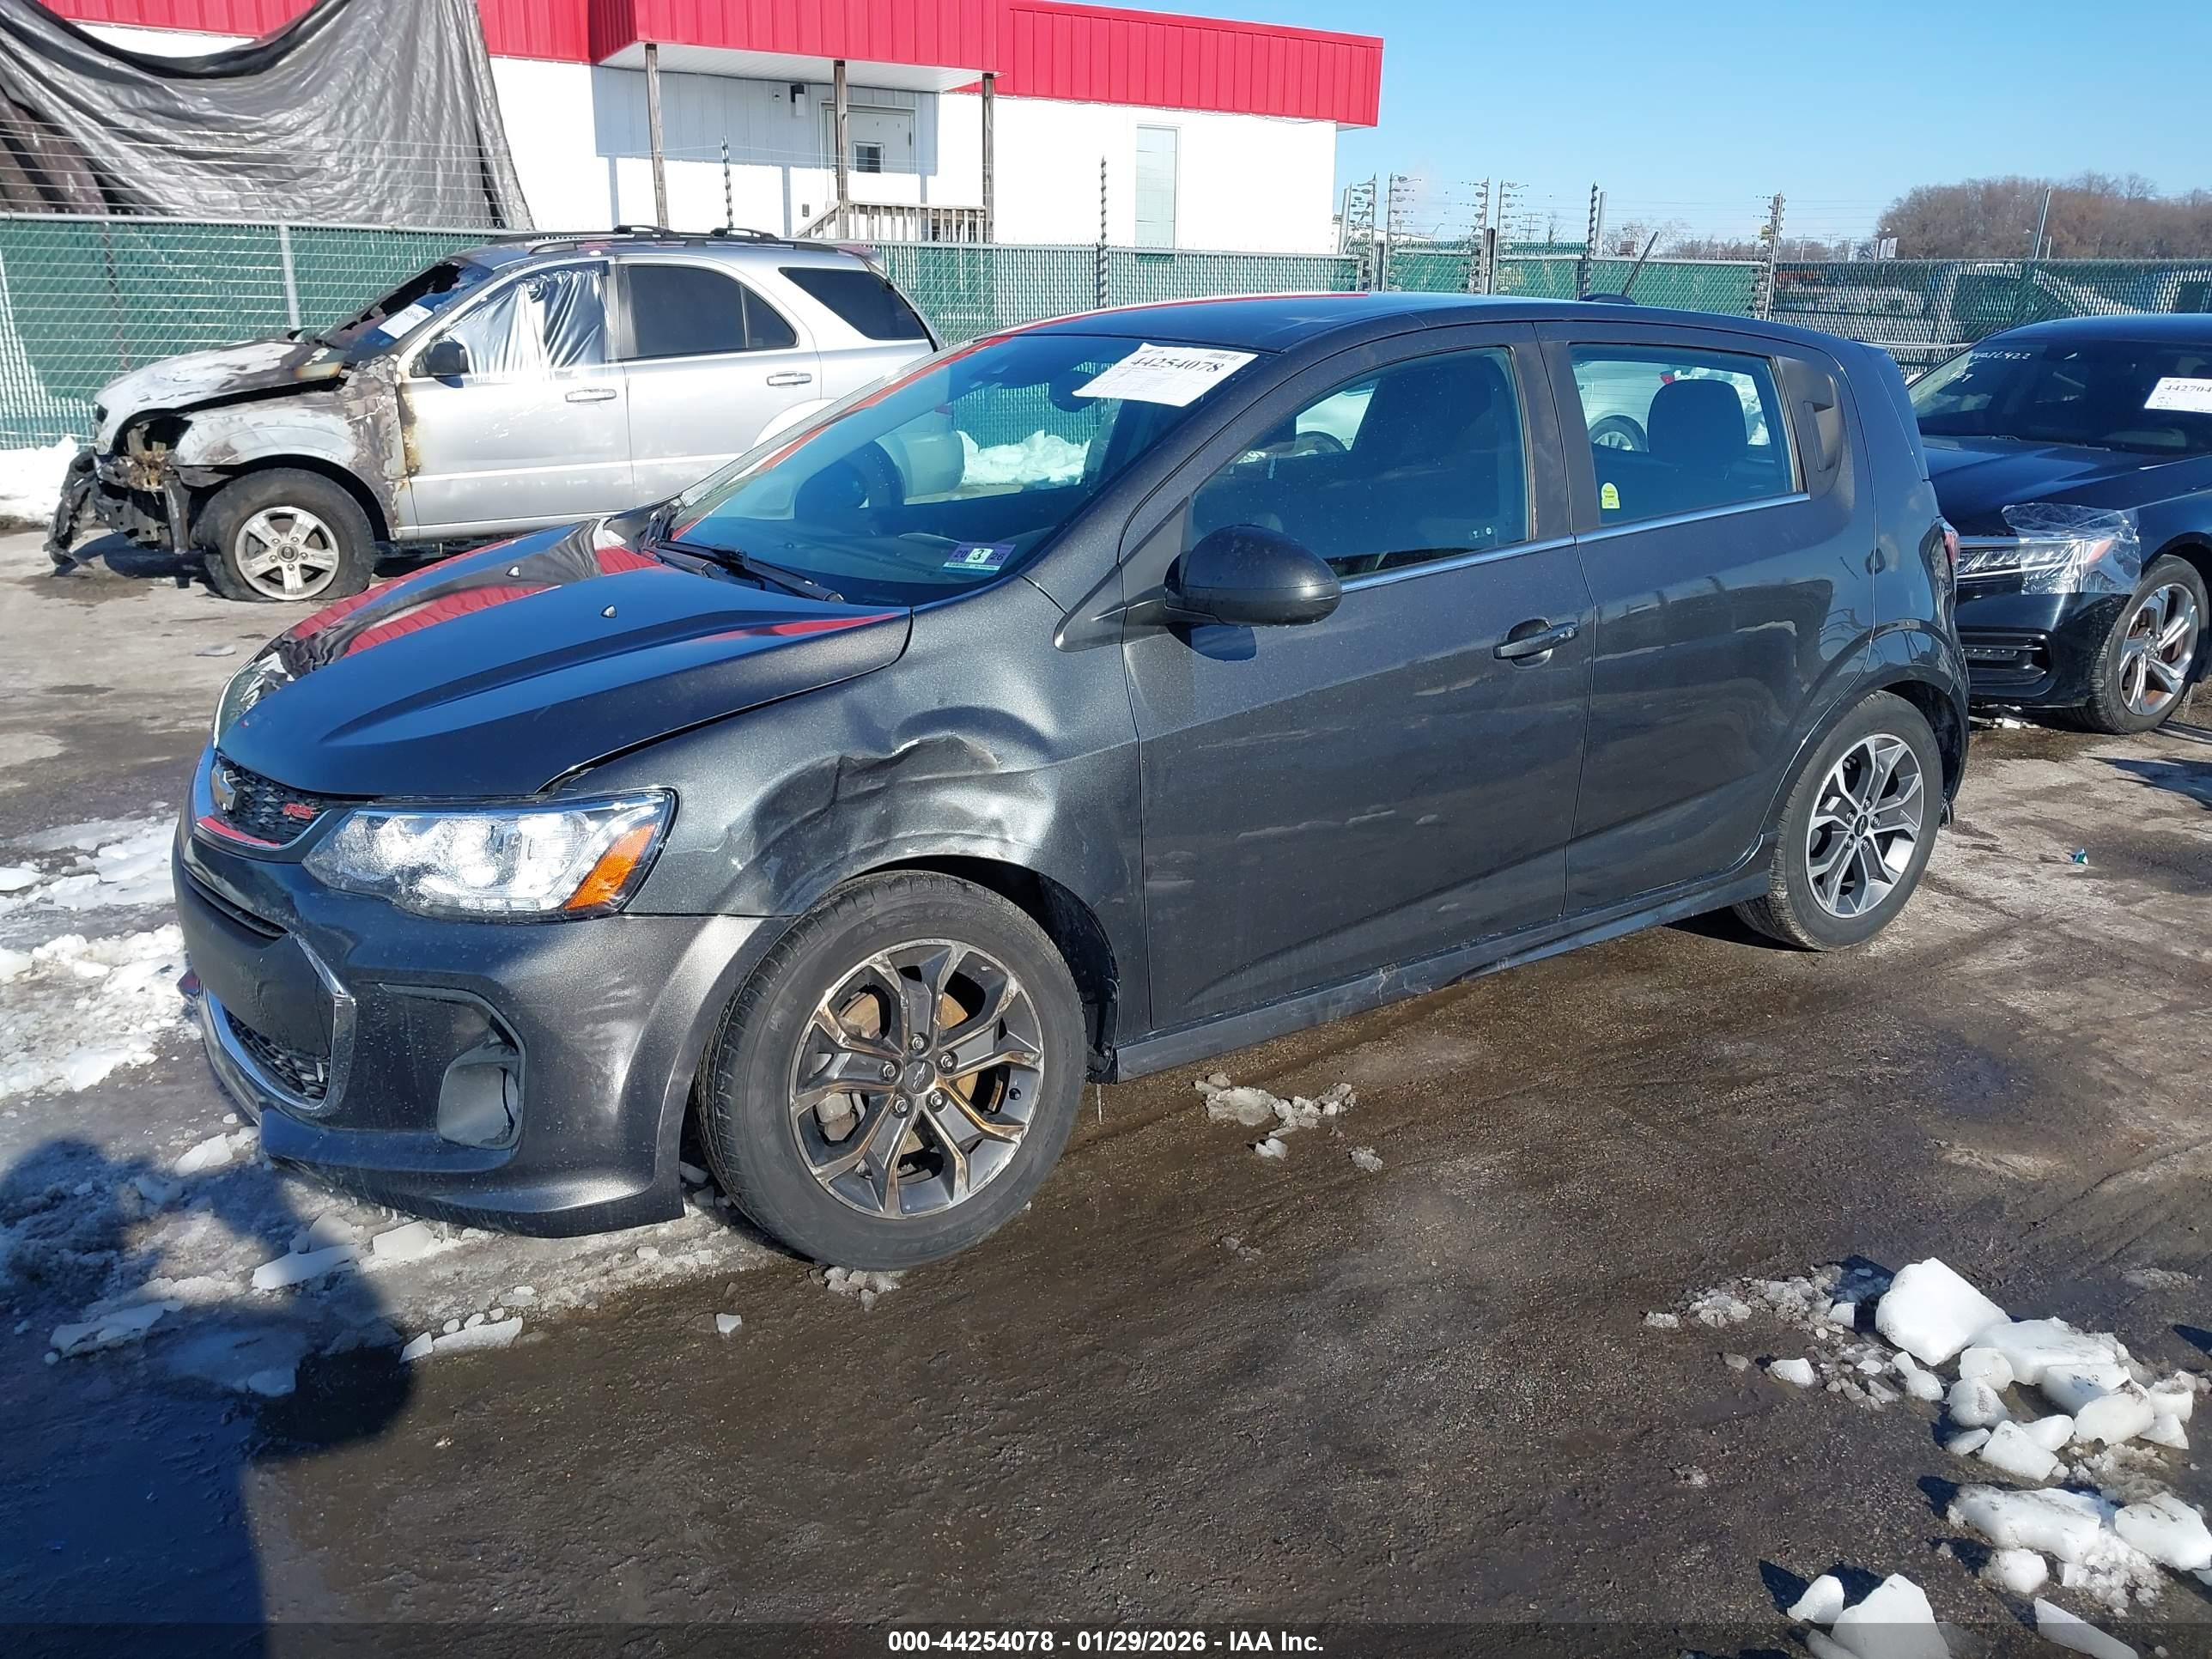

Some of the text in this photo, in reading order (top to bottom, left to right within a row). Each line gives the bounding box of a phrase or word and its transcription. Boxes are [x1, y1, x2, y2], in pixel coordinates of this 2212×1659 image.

[1131, 356, 1225, 373] 44254078
[973, 549, 985, 561] 3
[283, 803, 317, 820] RS
